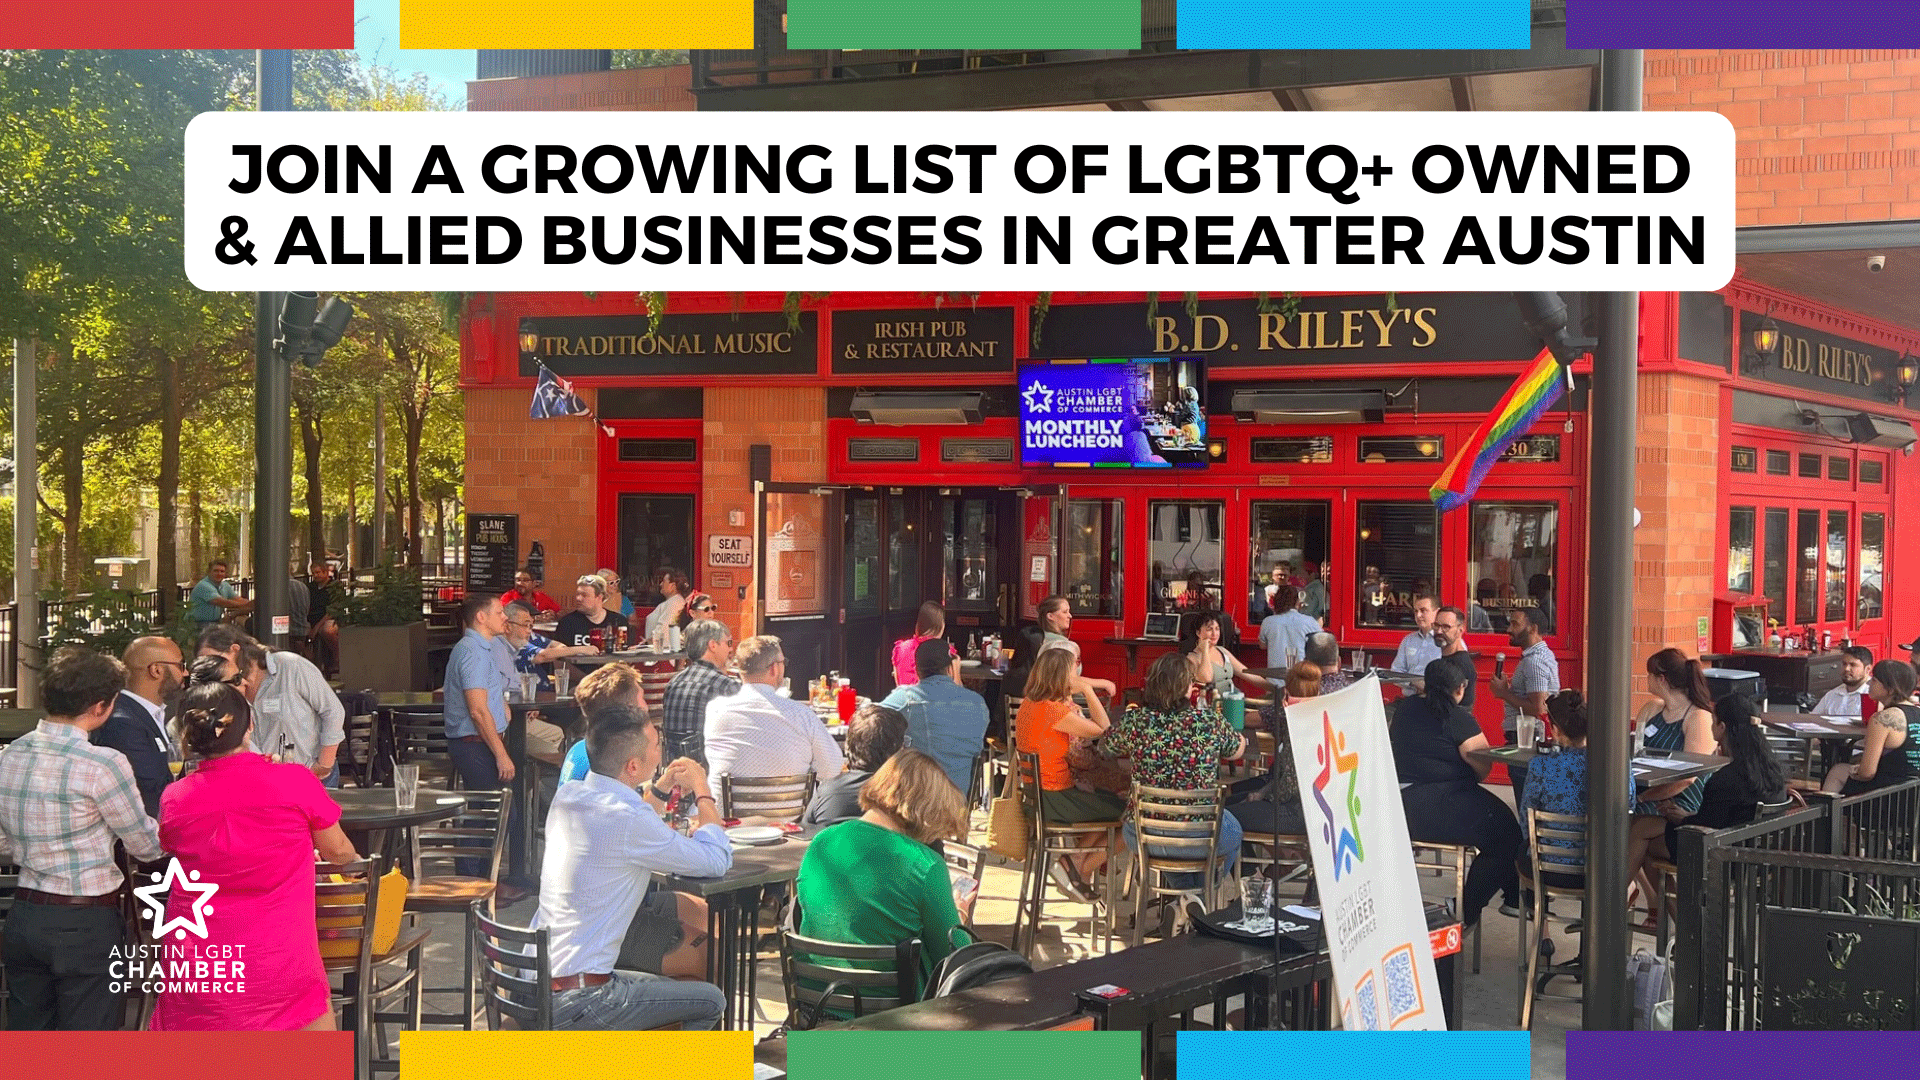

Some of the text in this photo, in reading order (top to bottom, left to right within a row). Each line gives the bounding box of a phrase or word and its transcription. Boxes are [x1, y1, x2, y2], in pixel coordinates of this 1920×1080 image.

[875, 321, 967, 339] IRISH PUB
[1153, 308, 1437, 353] B.D. RILEY'S
[541, 332, 791, 356] TRADITIONAL MUSIC
[844, 341, 998, 360] & RESTAURANT
[1782, 334, 1872, 387] B.D. RILEY'S
[1057, 387, 1123, 396] AUSTIN LGBT
[1057, 396, 1123, 406] CHAMBER
[1057, 406, 1070, 414] OF
[1025, 420, 1123, 435] MONTHLY
[1025, 434, 1124, 448] LUNCHEON
[479, 520, 505, 530] SLANE
[476, 534, 489, 543] PUB
[718, 539, 742, 550] SEAT
[711, 552, 750, 564] YOURSELF
